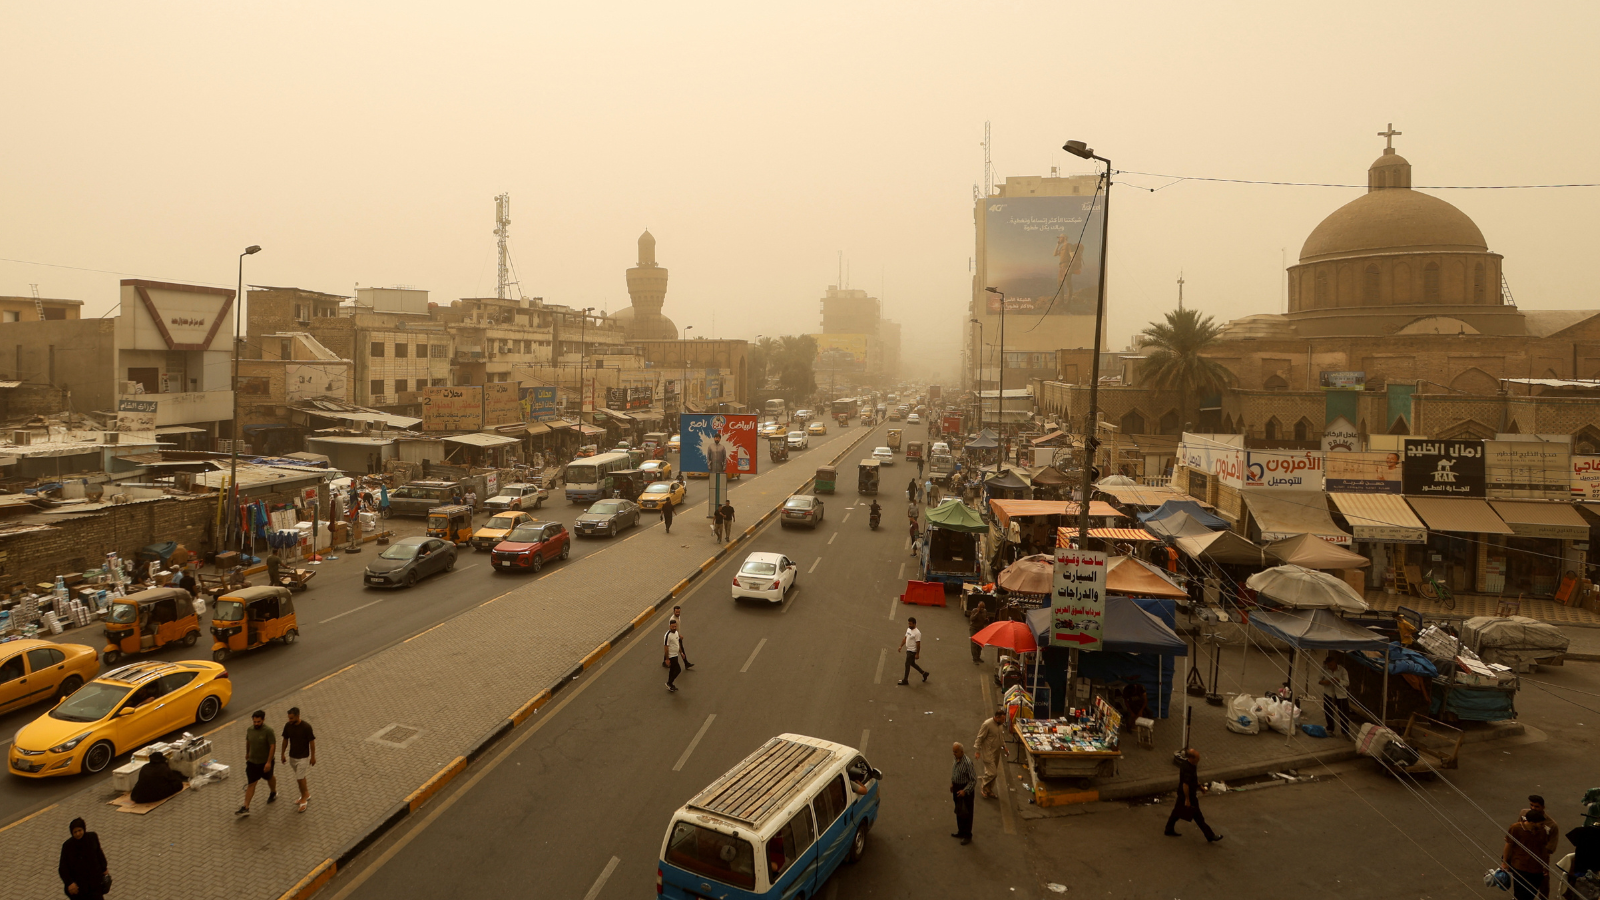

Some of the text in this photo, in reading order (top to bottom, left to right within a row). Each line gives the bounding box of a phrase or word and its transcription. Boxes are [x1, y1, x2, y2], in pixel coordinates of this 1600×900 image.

[443, 389, 463, 399] محلات
[120, 402, 156, 412] كرزات الشام
[424, 397, 432, 406] 2
[688, 419, 756, 433] البياض ناصع
[1343, 431, 1358, 439] عادل
[1327, 438, 1355, 448] PRIME
[1407, 442, 1483, 459] رمال الخليج
[1265, 451, 1321, 475] الأمزون
[1267, 475, 1303, 487] للتوصيل
[1433, 472, 1458, 483] RAK
[1057, 552, 1104, 567] ساحة وقوف
[1063, 570, 1097, 584] السيارت
[1057, 586, 1099, 602] والدراجات
[1054, 604, 1101, 618] سرداب السوق العربي
